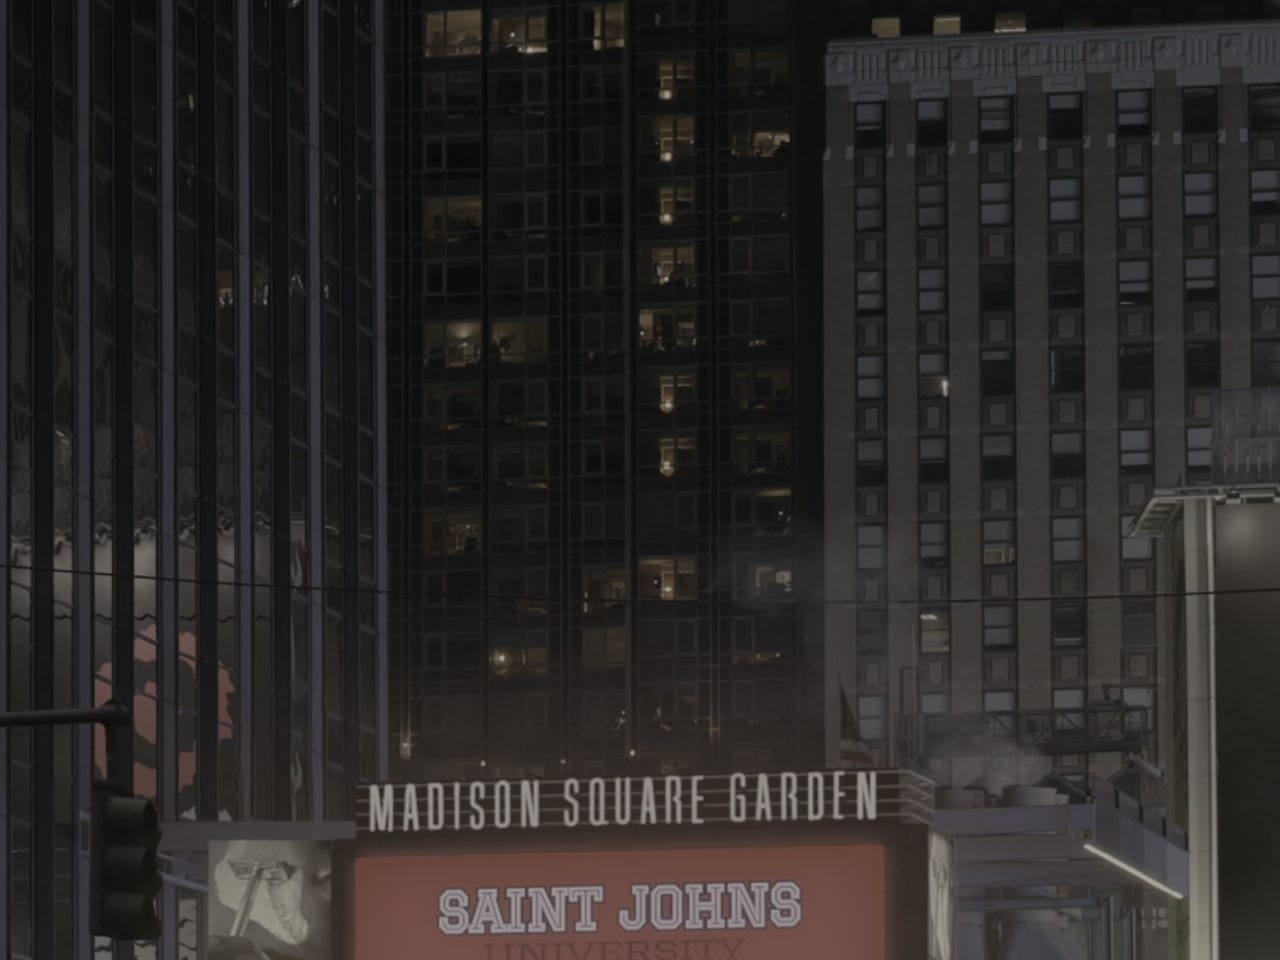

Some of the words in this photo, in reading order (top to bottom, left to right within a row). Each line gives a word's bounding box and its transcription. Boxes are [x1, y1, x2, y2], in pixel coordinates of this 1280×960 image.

[369, 779, 540, 832] MADISON
[563, 775, 705, 827] SQUARE
[729, 771, 878, 822] GARDEN
[437, 884, 605, 936] SAINT
[618, 880, 803, 932] JOHNS
